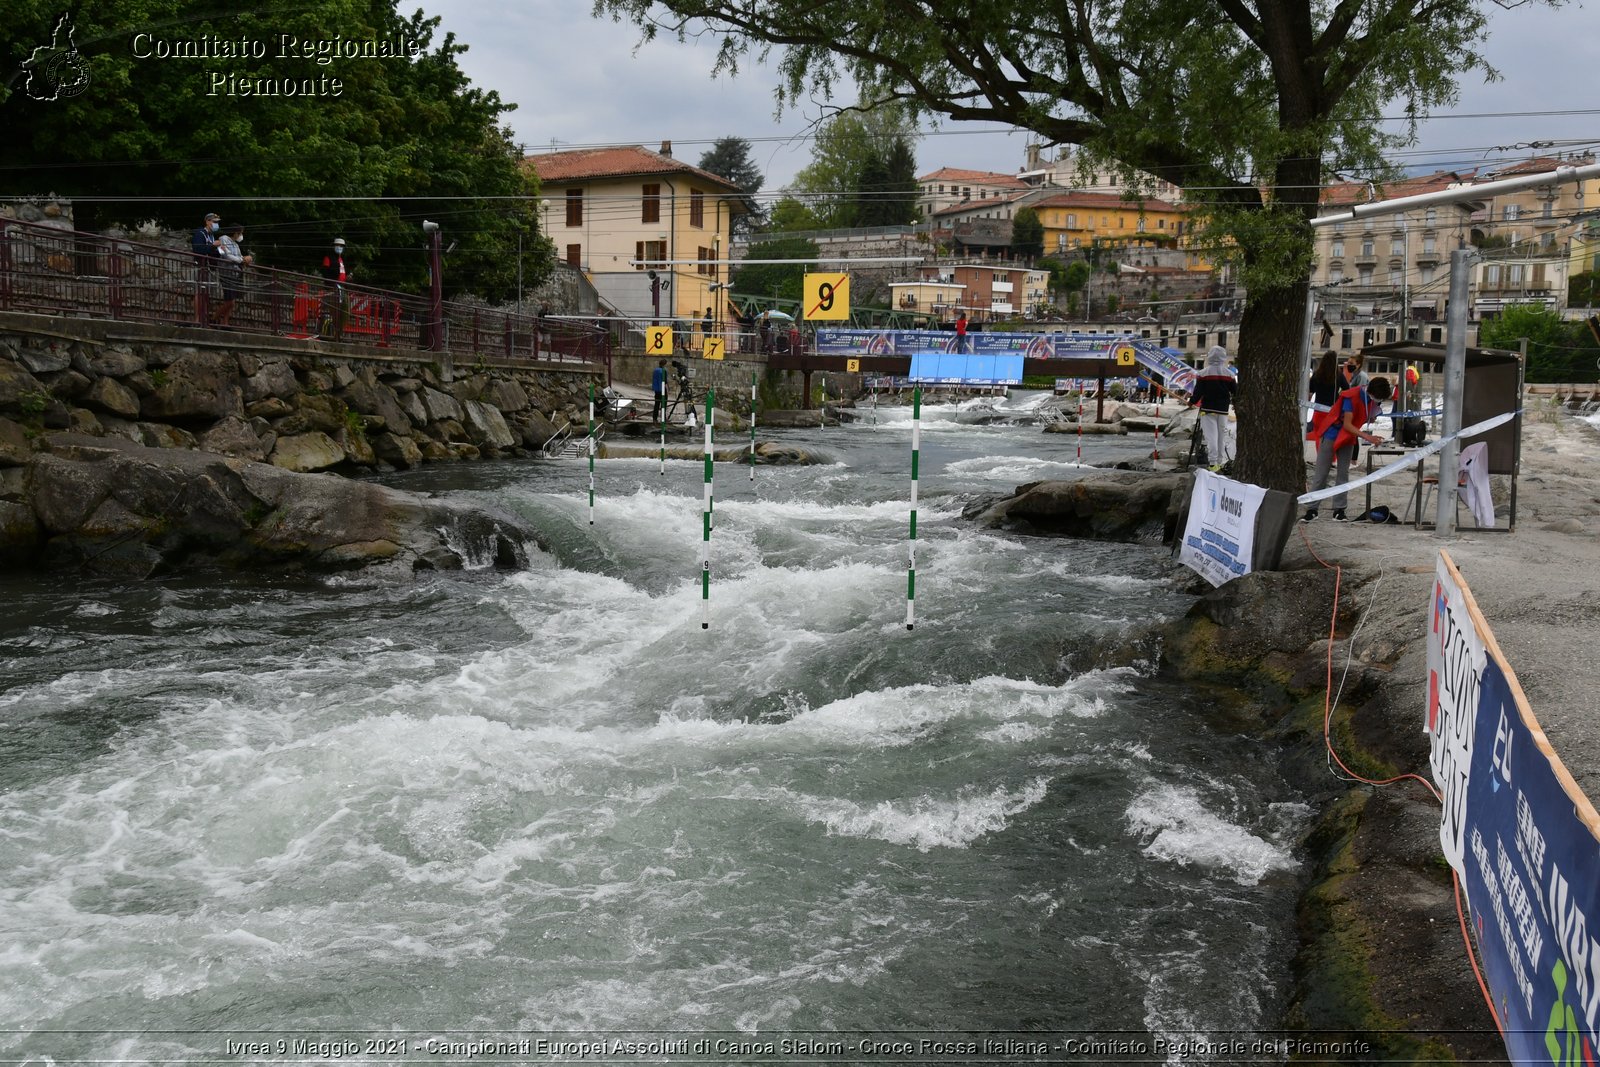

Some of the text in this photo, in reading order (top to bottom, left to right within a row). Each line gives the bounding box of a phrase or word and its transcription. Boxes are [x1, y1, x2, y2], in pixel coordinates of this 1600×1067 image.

[818, 282, 835, 311] 9
[653, 331, 664, 350] 8
[709, 342, 719, 357] 7
[1123, 351, 1130, 362] 6
[849, 359, 857, 370] 5
[1220, 488, 1243, 518] domus
[704, 560, 709, 570] 9
